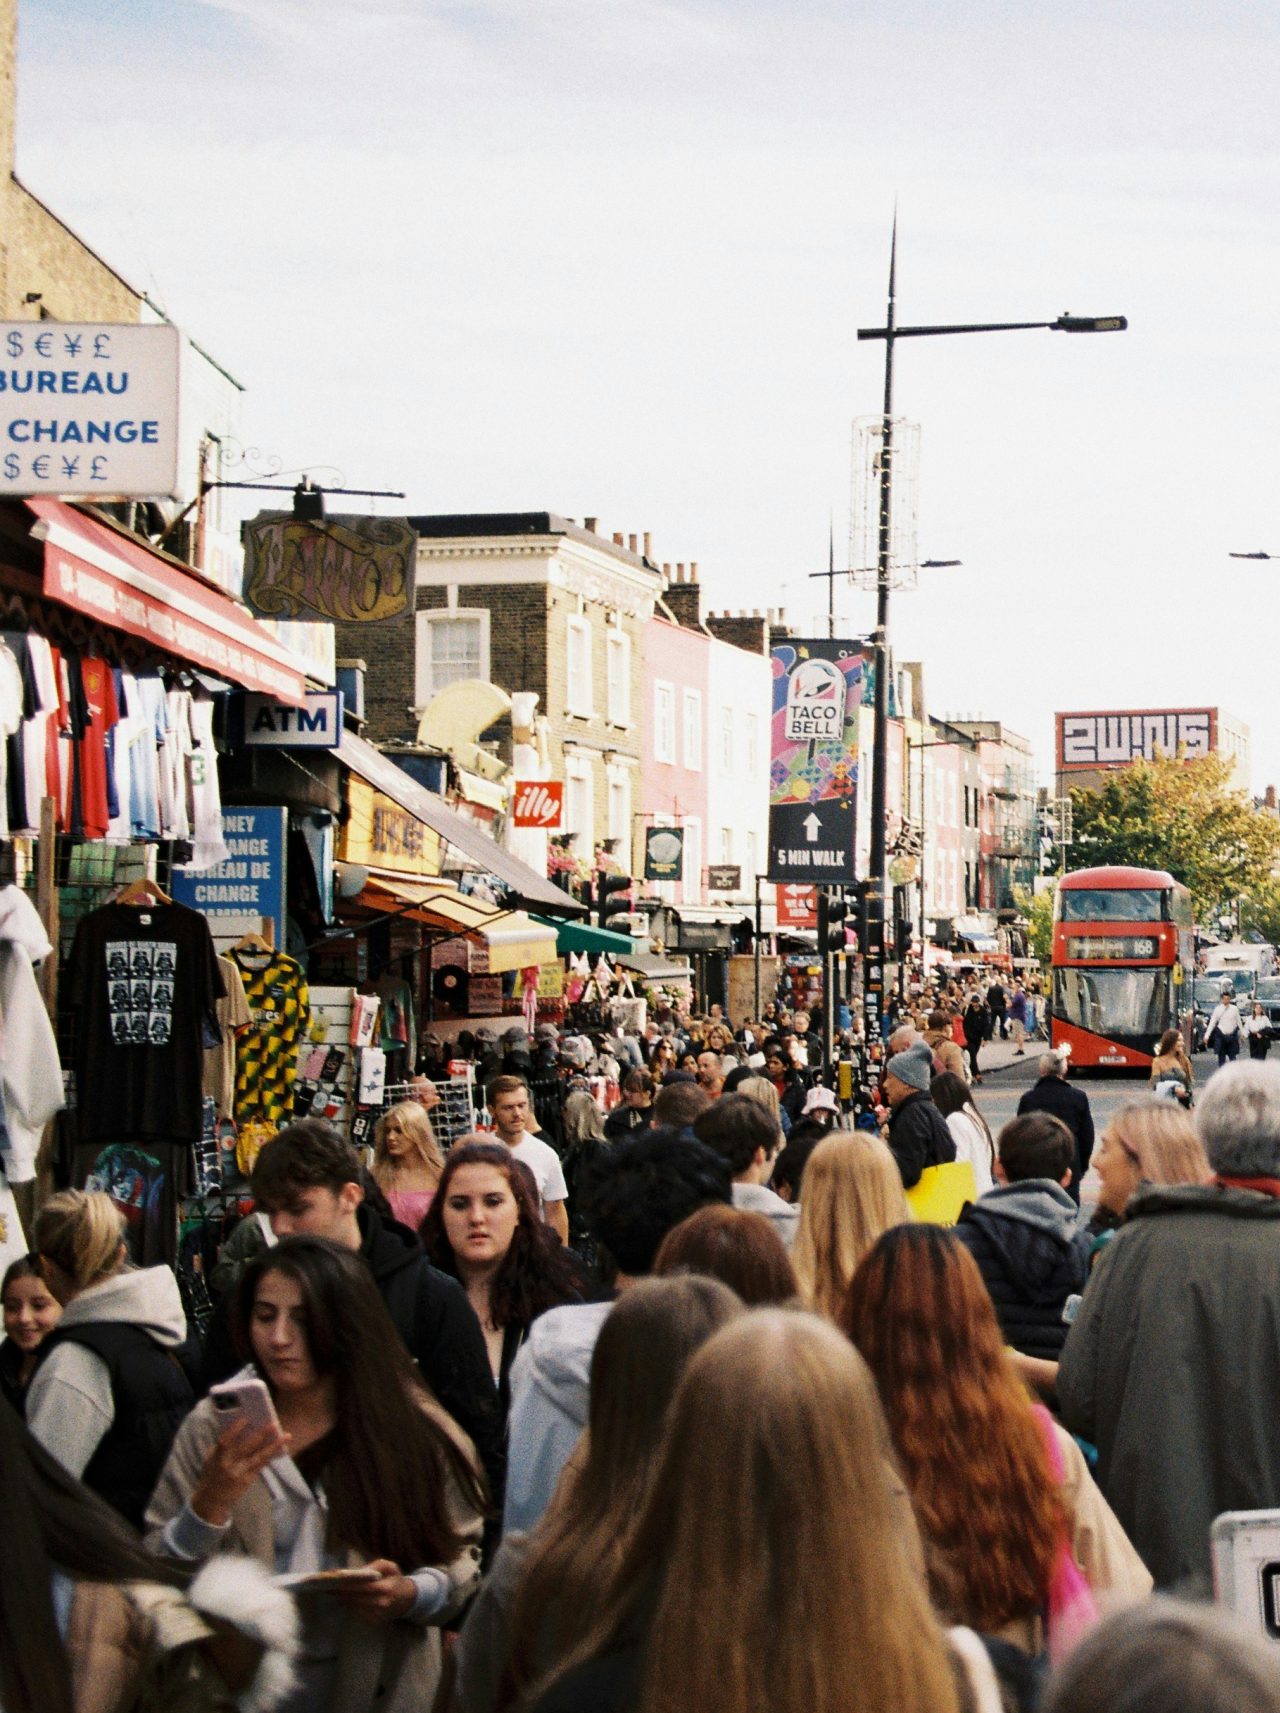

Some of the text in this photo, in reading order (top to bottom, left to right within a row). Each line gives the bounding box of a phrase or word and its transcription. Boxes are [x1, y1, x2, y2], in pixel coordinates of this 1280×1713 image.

[8, 419, 159, 443] CHANGE
[252, 706, 327, 732] ATM
[790, 706, 836, 720] TACO
[792, 721, 834, 734] BELL
[516, 786, 560, 824] illy
[778, 850, 845, 866] 5 MIN WALK
[251, 862, 271, 879] DE
[195, 885, 259, 902] CHANGE
[1134, 940, 1153, 954] 168
